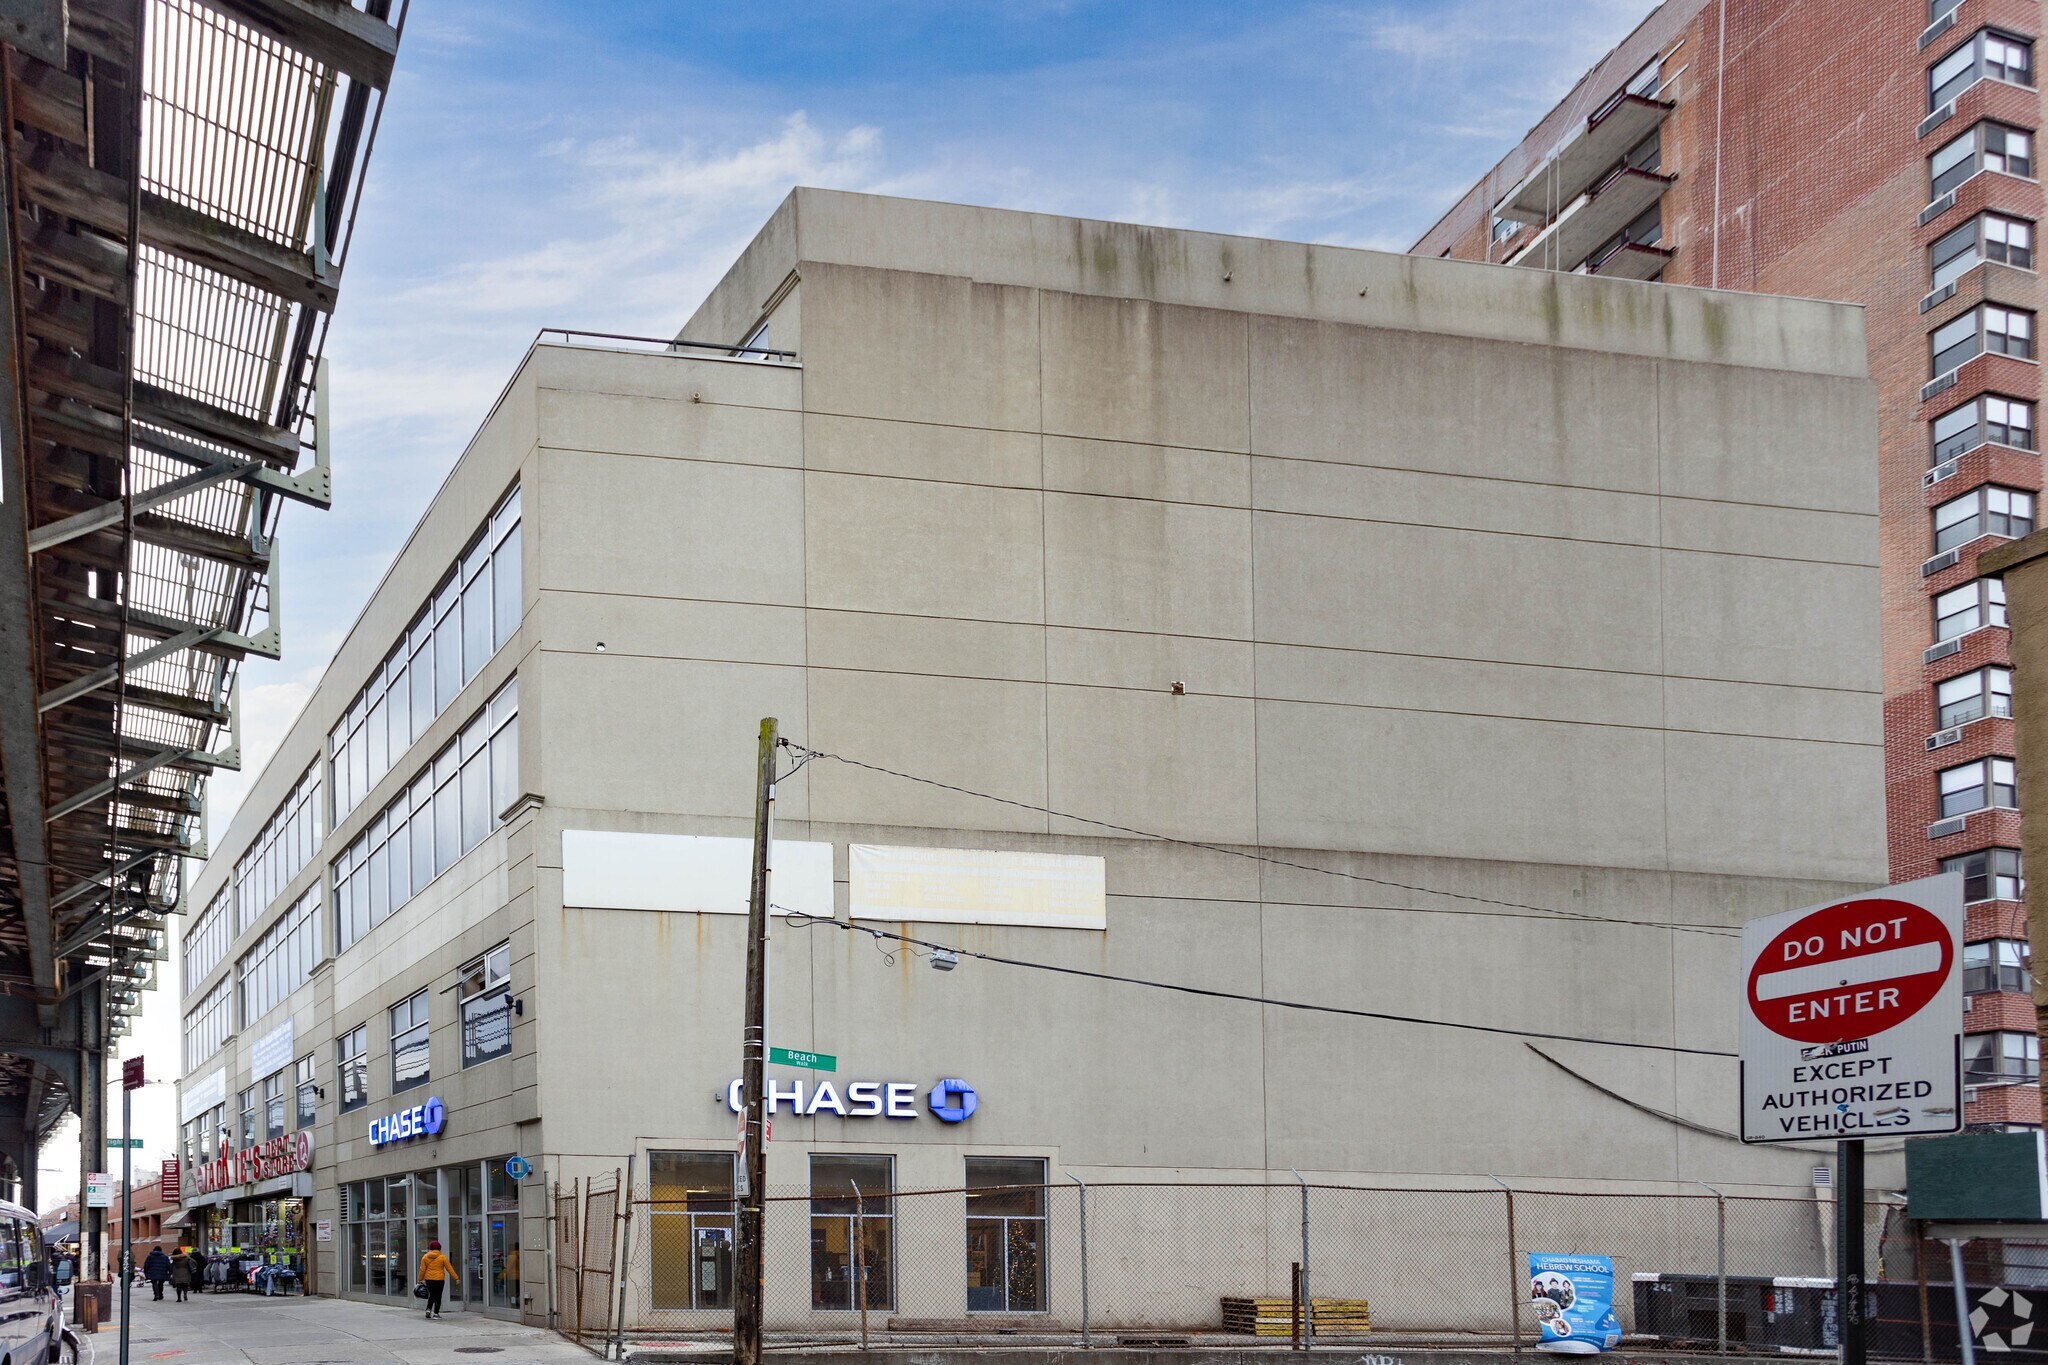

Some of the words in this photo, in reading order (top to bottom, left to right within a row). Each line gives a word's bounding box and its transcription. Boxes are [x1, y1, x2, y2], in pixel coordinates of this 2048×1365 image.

[1783, 935, 1824, 962] DO
[1840, 917, 1908, 950] NOT
[1788, 987, 1900, 1023] ENTER
[787, 1050, 817, 1063] Beach
[1802, 1043, 1833, 1057] FK
[1837, 1040, 1867, 1054] PUTIN
[1793, 1056, 1893, 1083] EXCEPT
[1762, 1080, 1932, 1110] AUTHORIZED
[369, 1105, 423, 1146] CHASE
[265, 1134, 290, 1159] DEPT
[263, 1153, 295, 1179] STORE
[1537, 1263, 1573, 1271] HEBREW
[1574, 1265, 1610, 1273] SCHOOL
